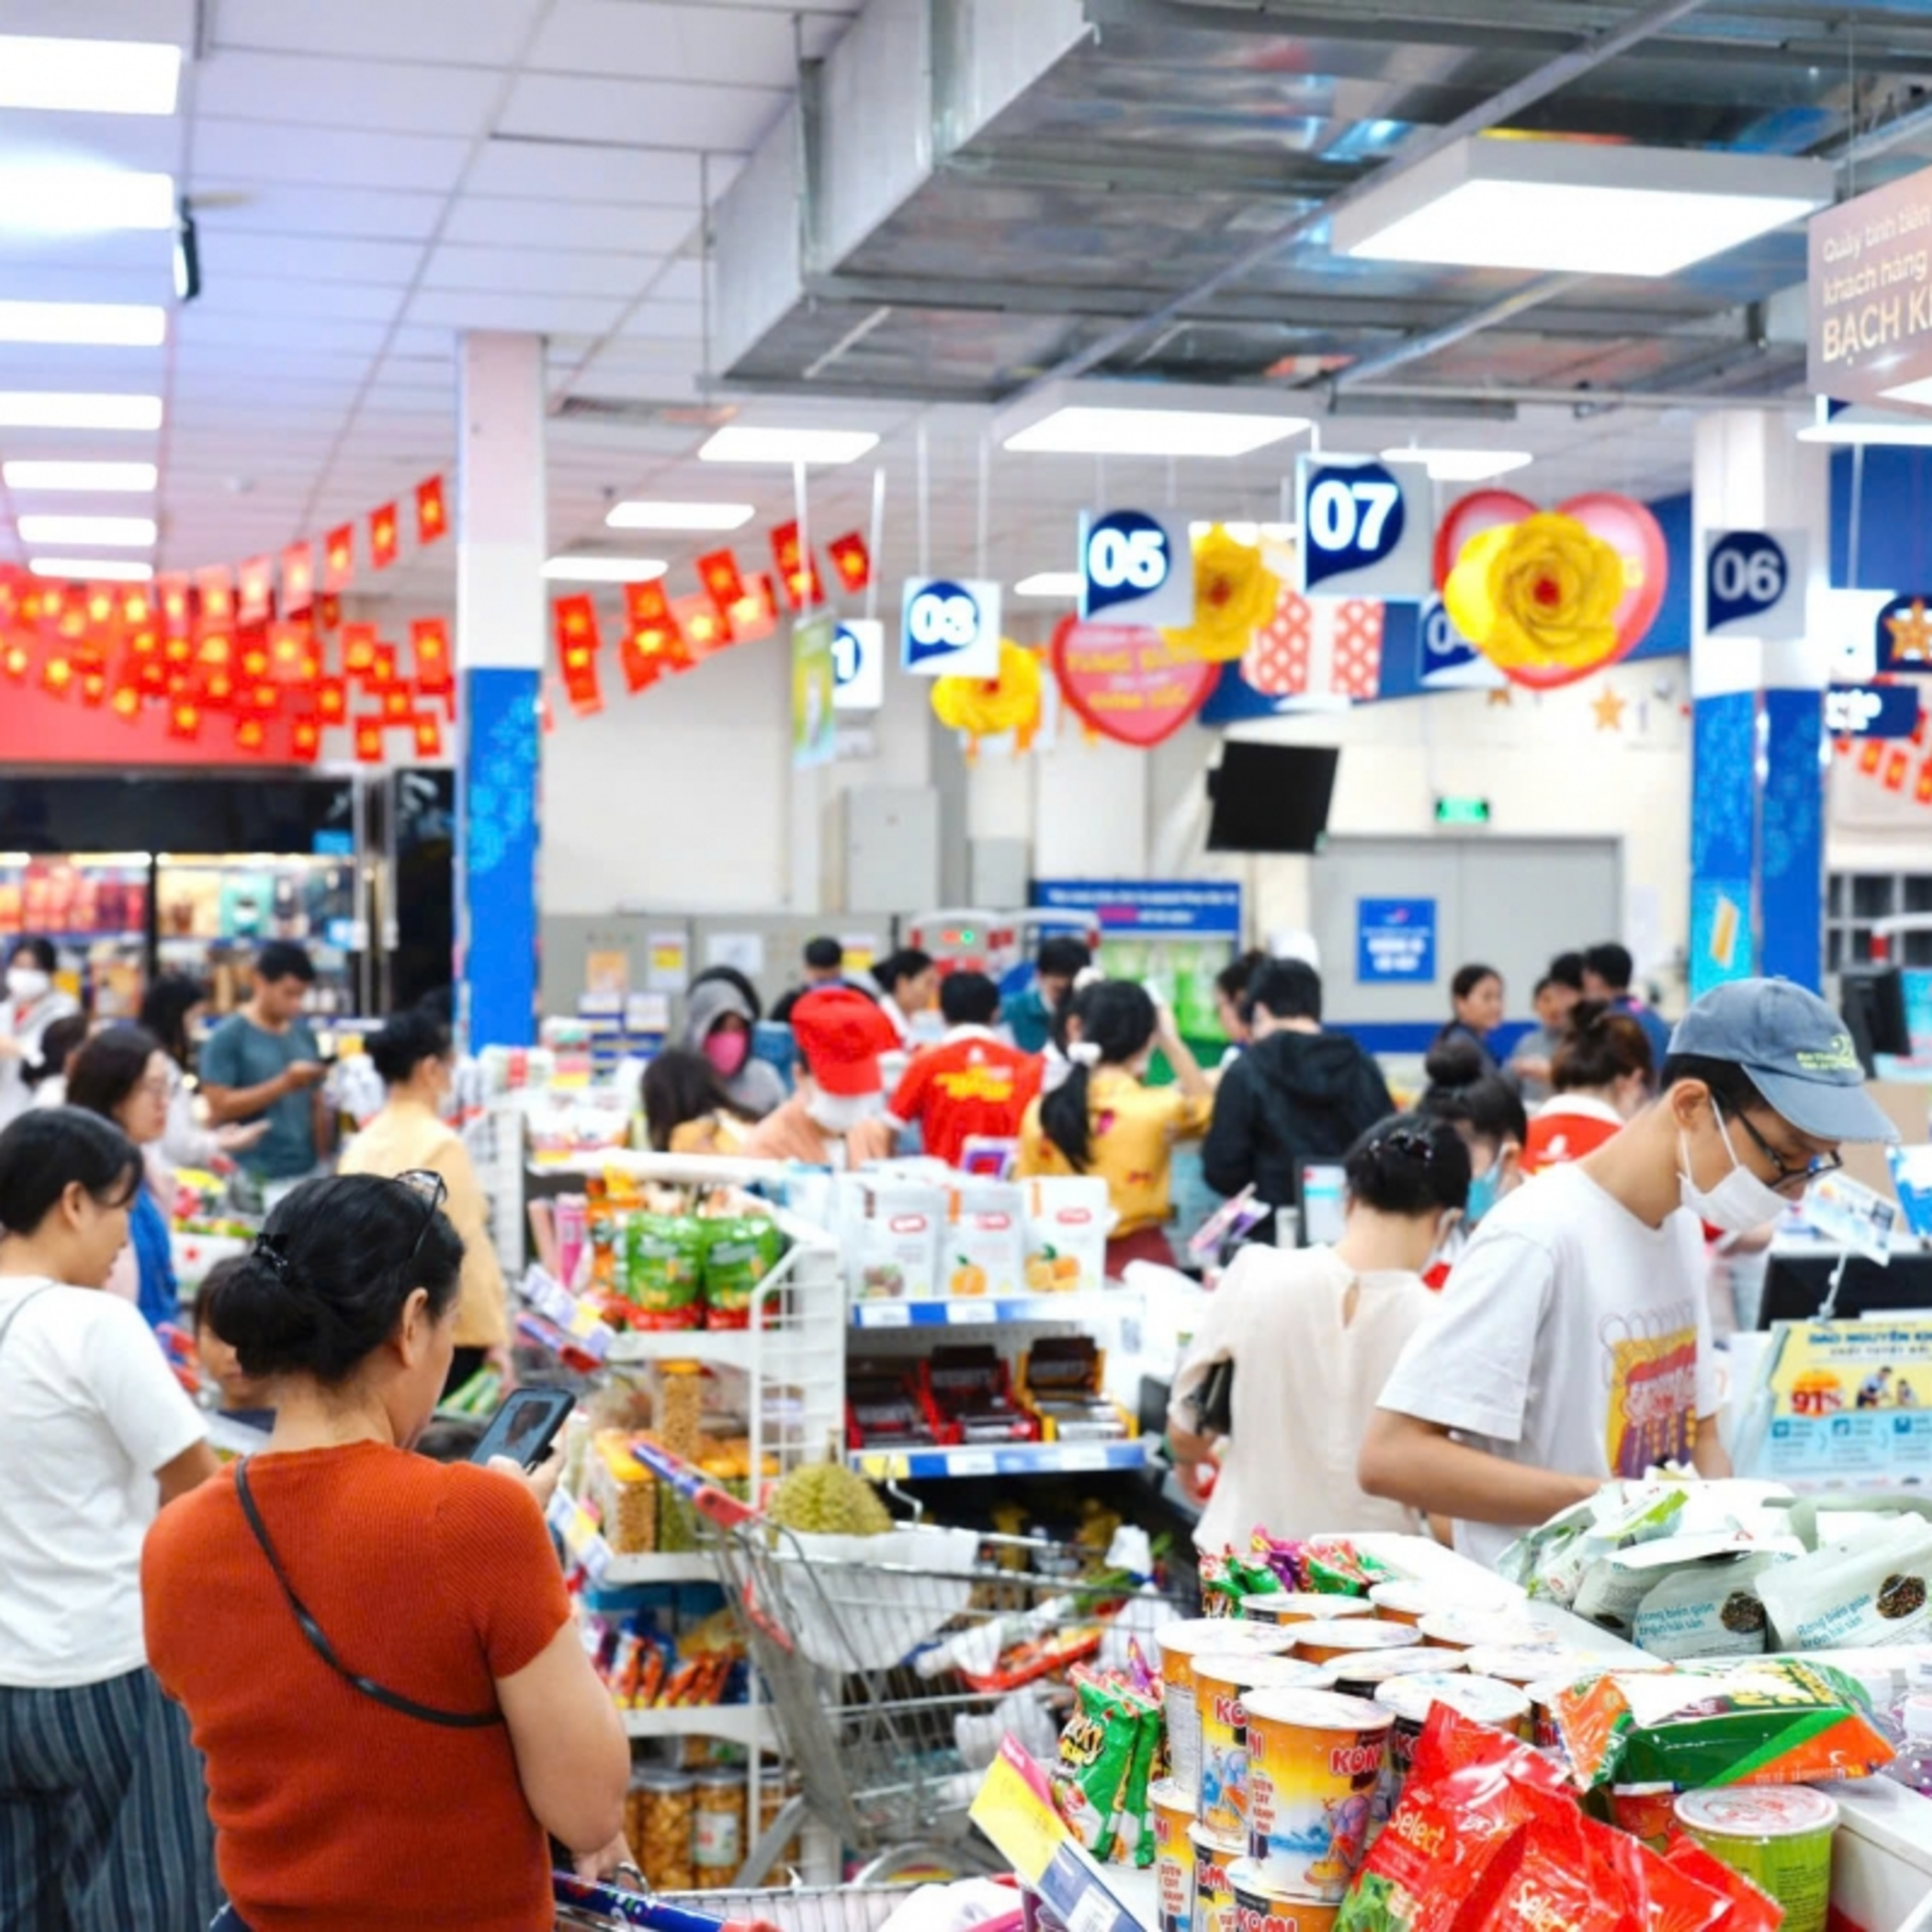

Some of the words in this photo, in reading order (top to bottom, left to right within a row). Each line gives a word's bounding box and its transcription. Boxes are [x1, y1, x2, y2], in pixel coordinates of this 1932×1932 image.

[1823, 296, 1900, 366] BẠCH
[1307, 480, 1399, 551] 07
[1088, 529, 1168, 589] 05
[1713, 549, 1781, 602] 06
[1214, 1694, 1248, 1728] KO
[1388, 1801, 1446, 1859] Select
